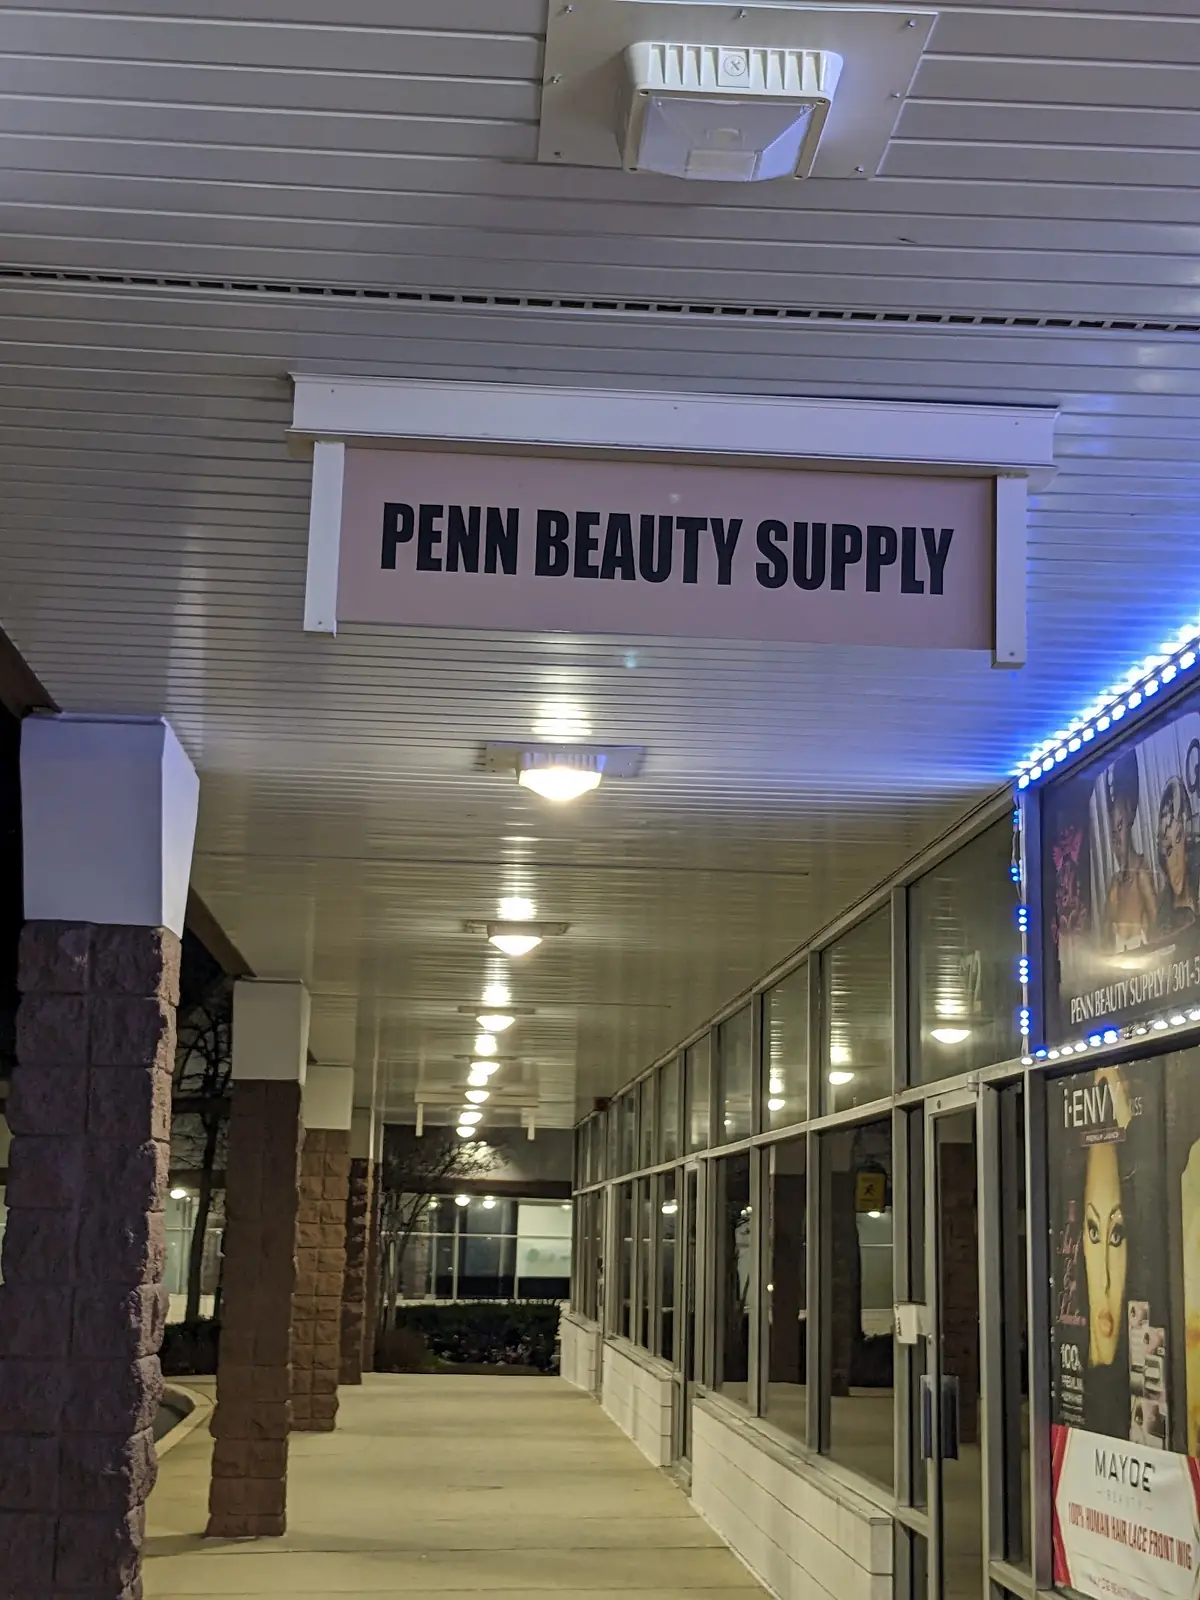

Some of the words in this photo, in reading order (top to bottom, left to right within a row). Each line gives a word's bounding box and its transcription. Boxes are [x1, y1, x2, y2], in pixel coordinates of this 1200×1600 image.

[380, 502, 520, 576] PENN
[534, 508, 742, 586] BEAUTY
[755, 518, 955, 596] SUPPLY
[1070, 991, 1094, 1024] PENN
[1095, 980, 1129, 1016] BEAUTY
[1129, 967, 1164, 1007] SUPPLY
[1085, 1507, 1109, 1538] HUMAN
[1111, 1515, 1127, 1546] HAIR
[1128, 1522, 1148, 1552] LACE
[1149, 1529, 1174, 1562] FRONT
[1175, 1538, 1192, 1571] WIG
